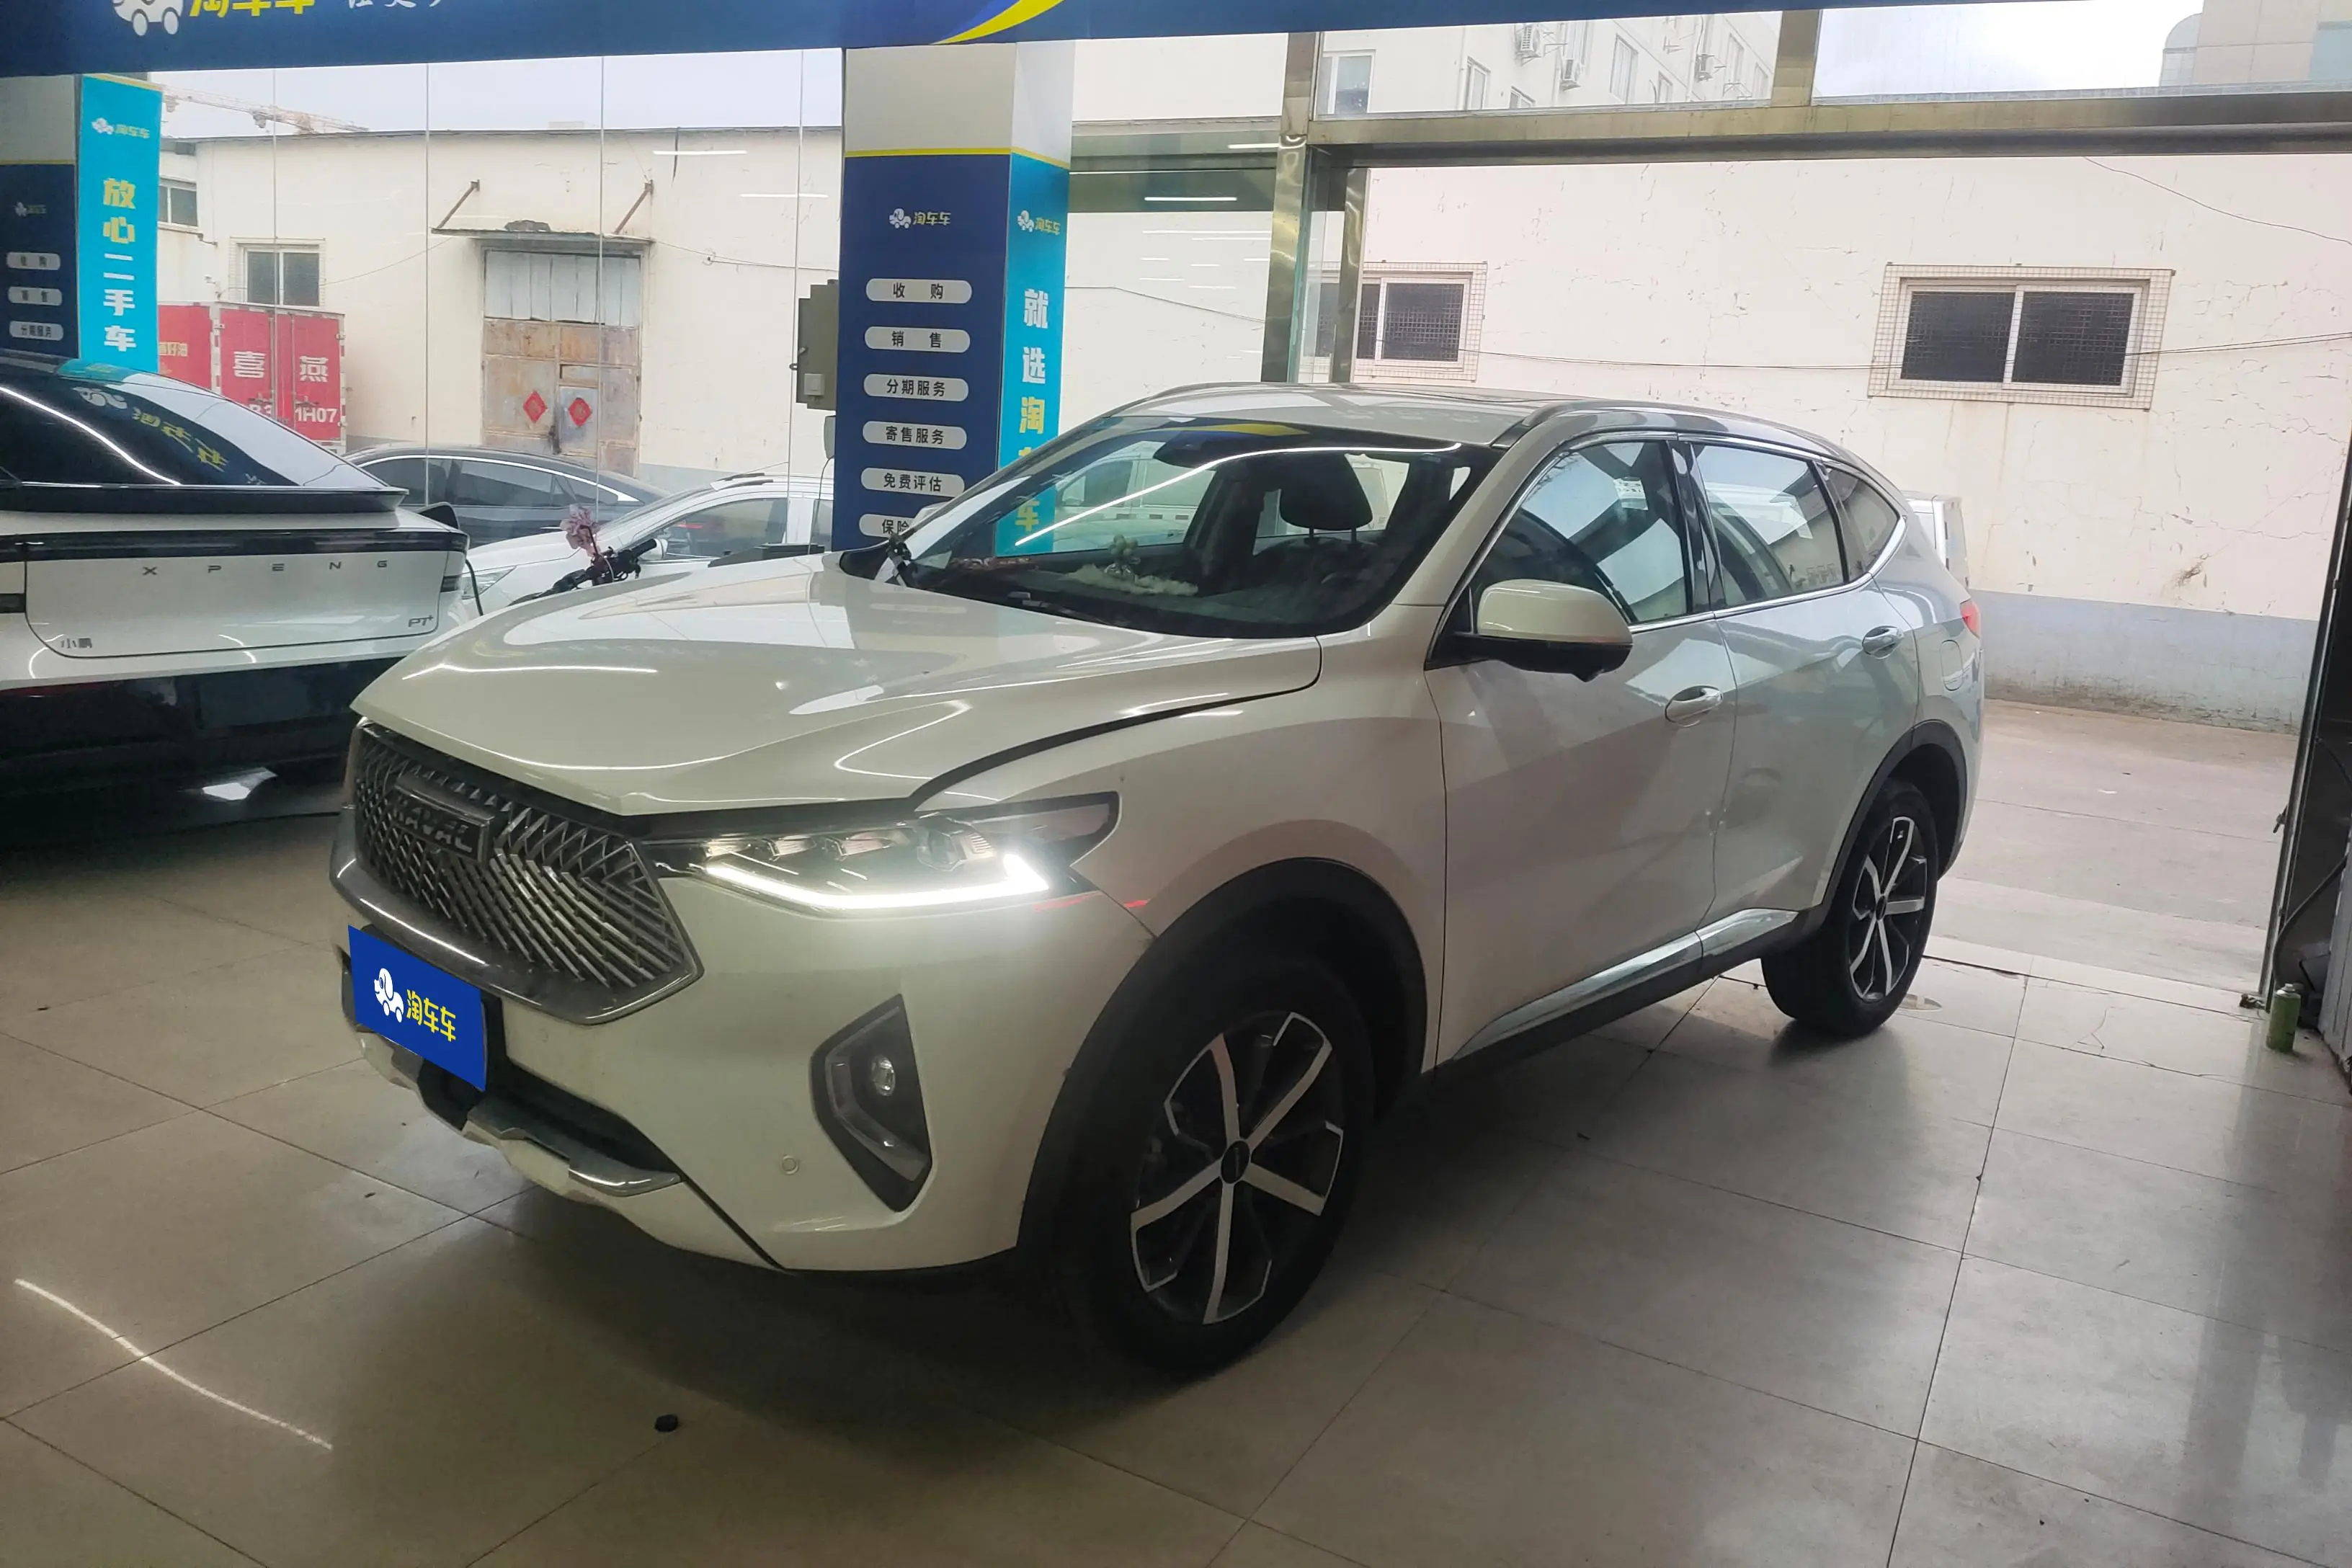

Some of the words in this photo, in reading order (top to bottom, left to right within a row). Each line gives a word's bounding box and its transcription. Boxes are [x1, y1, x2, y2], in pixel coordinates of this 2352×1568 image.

[913, 211, 951, 226] 淘车车
[102, 177, 137, 352] 放心二手车
[892, 282, 944, 300] 收购
[891, 331, 943, 349] 销售
[886, 379, 946, 398] 分期服务
[885, 425, 945, 445] 寄售服务
[883, 472, 943, 492] 免费评估
[143, 559, 388, 576] XPENG
